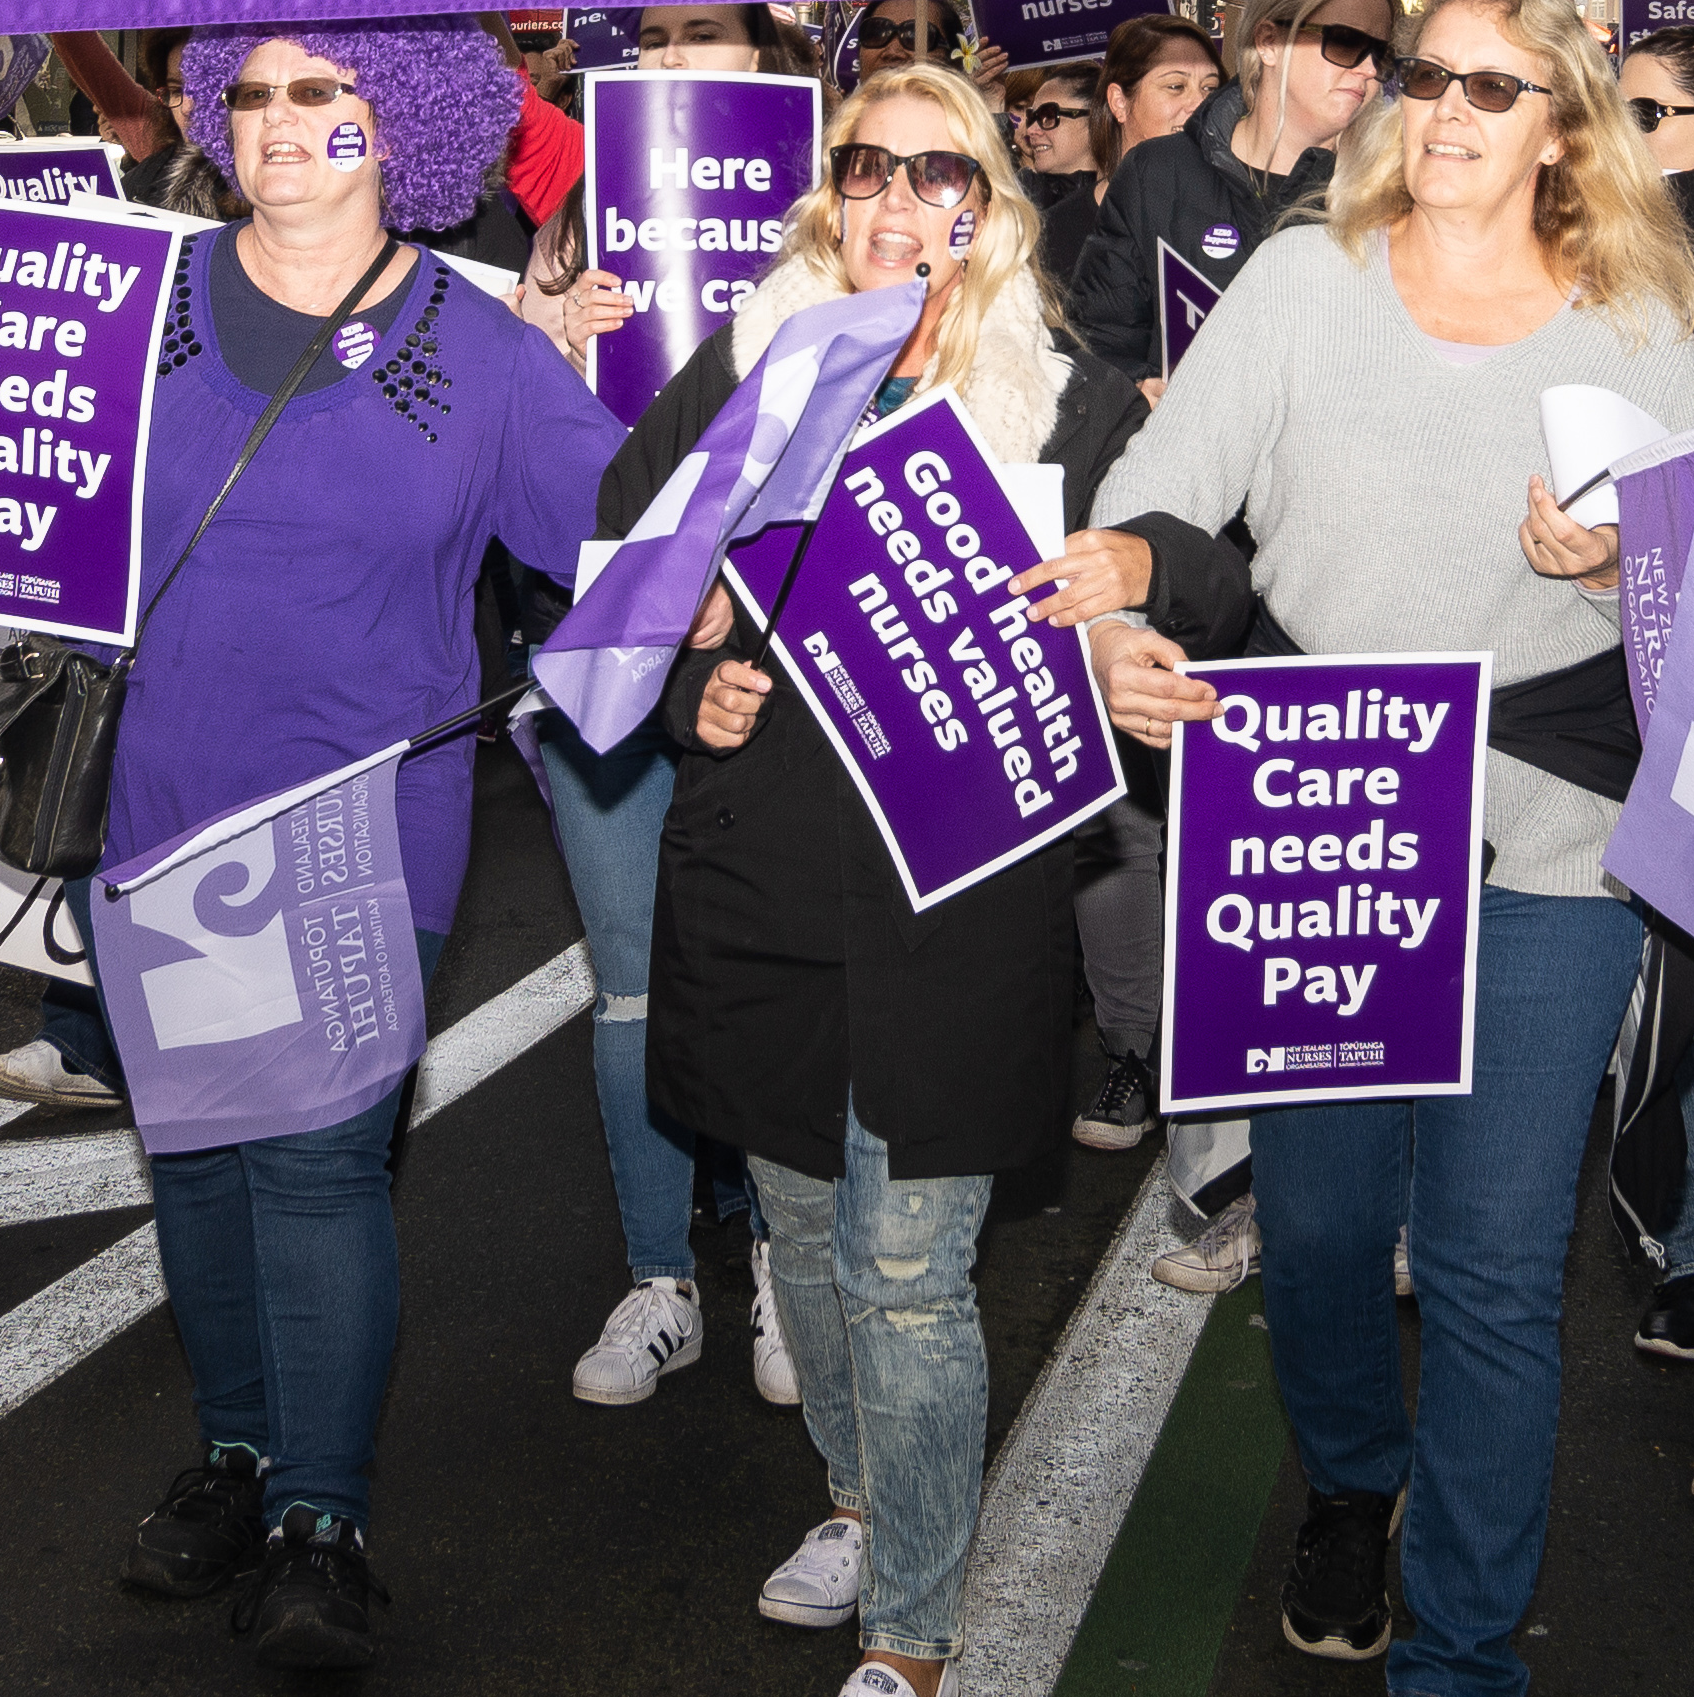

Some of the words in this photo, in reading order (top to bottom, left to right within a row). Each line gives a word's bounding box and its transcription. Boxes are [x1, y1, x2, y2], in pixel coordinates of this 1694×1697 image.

[650, 147, 772, 192] Here
[606, 206, 783, 253] becaus
[701, 279, 757, 313] ca
[1651, 547, 1669, 605] NEW
[844, 465, 959, 625] needs
[947, 625, 1055, 819] valued
[903, 449, 1014, 595] Good
[989, 593, 1083, 784] health
[830, 668, 859, 711] NURSES
[847, 572, 969, 753] nurses
[858, 714, 886, 757] TAPUHI
[1211, 688, 1450, 753] Quality
[1253, 758, 1400, 808] Care
[1229, 818, 1419, 876] needs
[1207, 884, 1441, 953] Quality
[1263, 957, 1378, 1016] Pay
[1287, 1051, 1332, 1063] NURSES
[1339, 1050, 1384, 1061] TAPUHI
